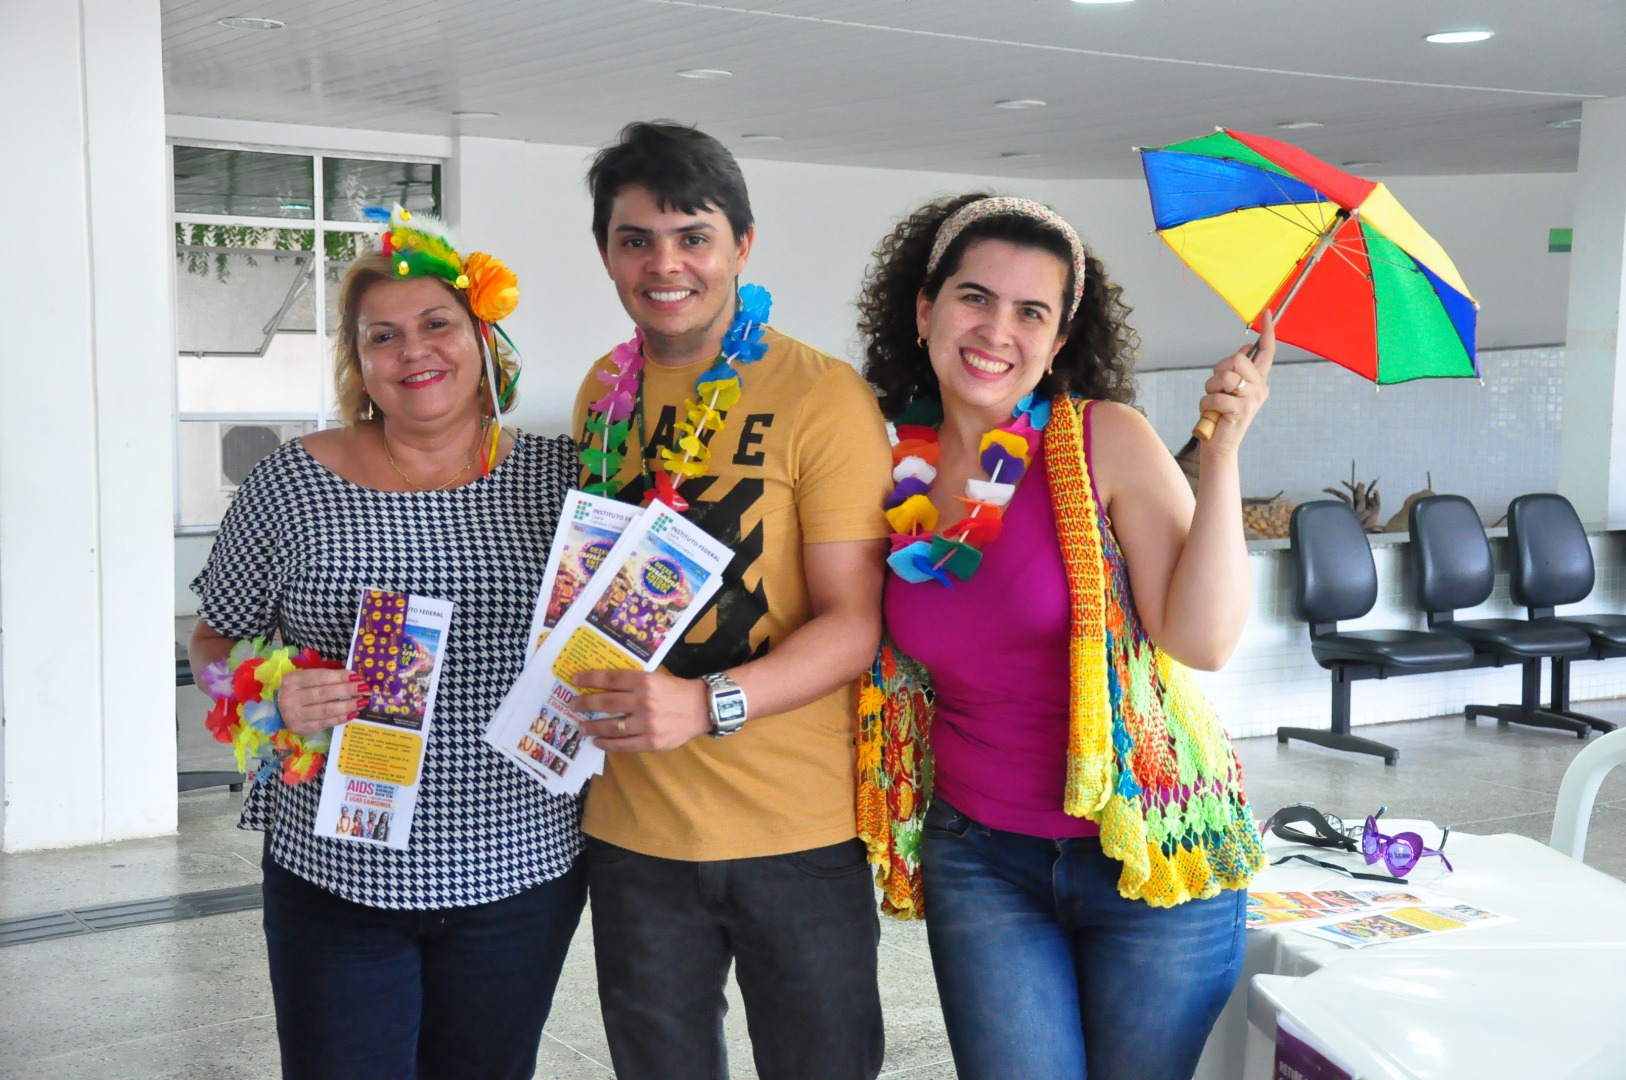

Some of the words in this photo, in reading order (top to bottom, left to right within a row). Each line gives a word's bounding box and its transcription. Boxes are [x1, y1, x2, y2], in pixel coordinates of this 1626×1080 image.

[593, 508, 624, 521] INSTITUTO
[671, 525, 699, 547] INSTITUTO
[698, 544, 720, 562] FEDERAL
[419, 608, 443, 618] FEDERAL
[553, 685, 573, 703] AID
[347, 779, 375, 795] AIDS
